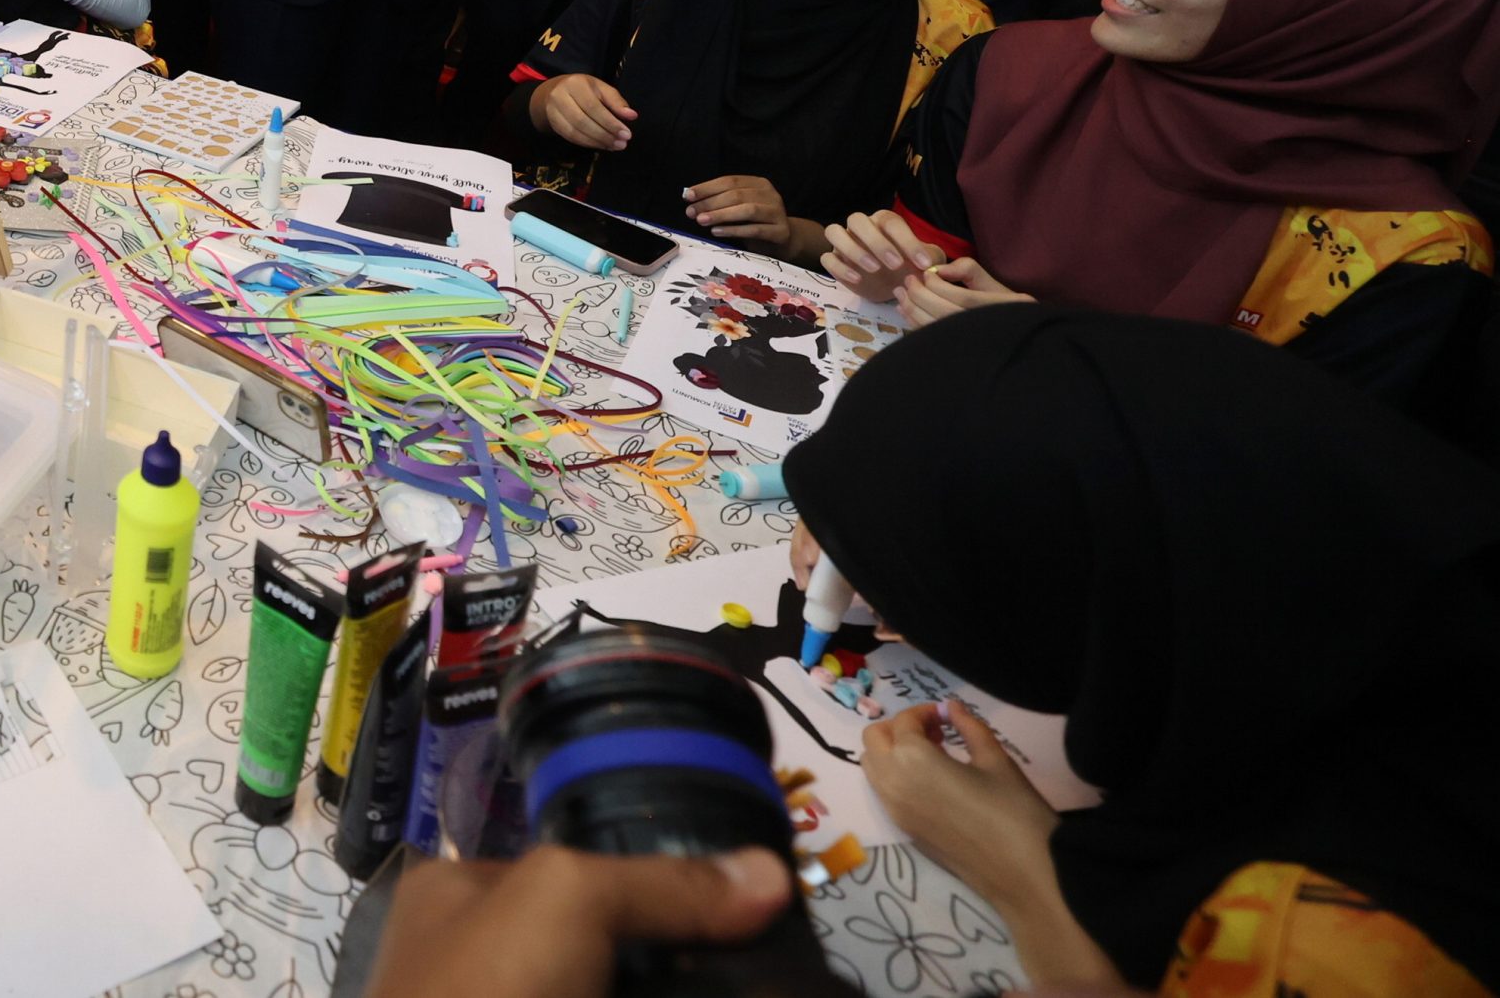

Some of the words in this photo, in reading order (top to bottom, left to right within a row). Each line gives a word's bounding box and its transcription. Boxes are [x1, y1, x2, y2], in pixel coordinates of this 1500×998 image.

[378, 163, 415, 175] stress
[420, 170, 449, 183] your
[672, 388, 712, 406] KOMUNITI
[263, 581, 317, 621] reeves
[465, 596, 517, 617] INTRO
[443, 686, 498, 710] reeves
